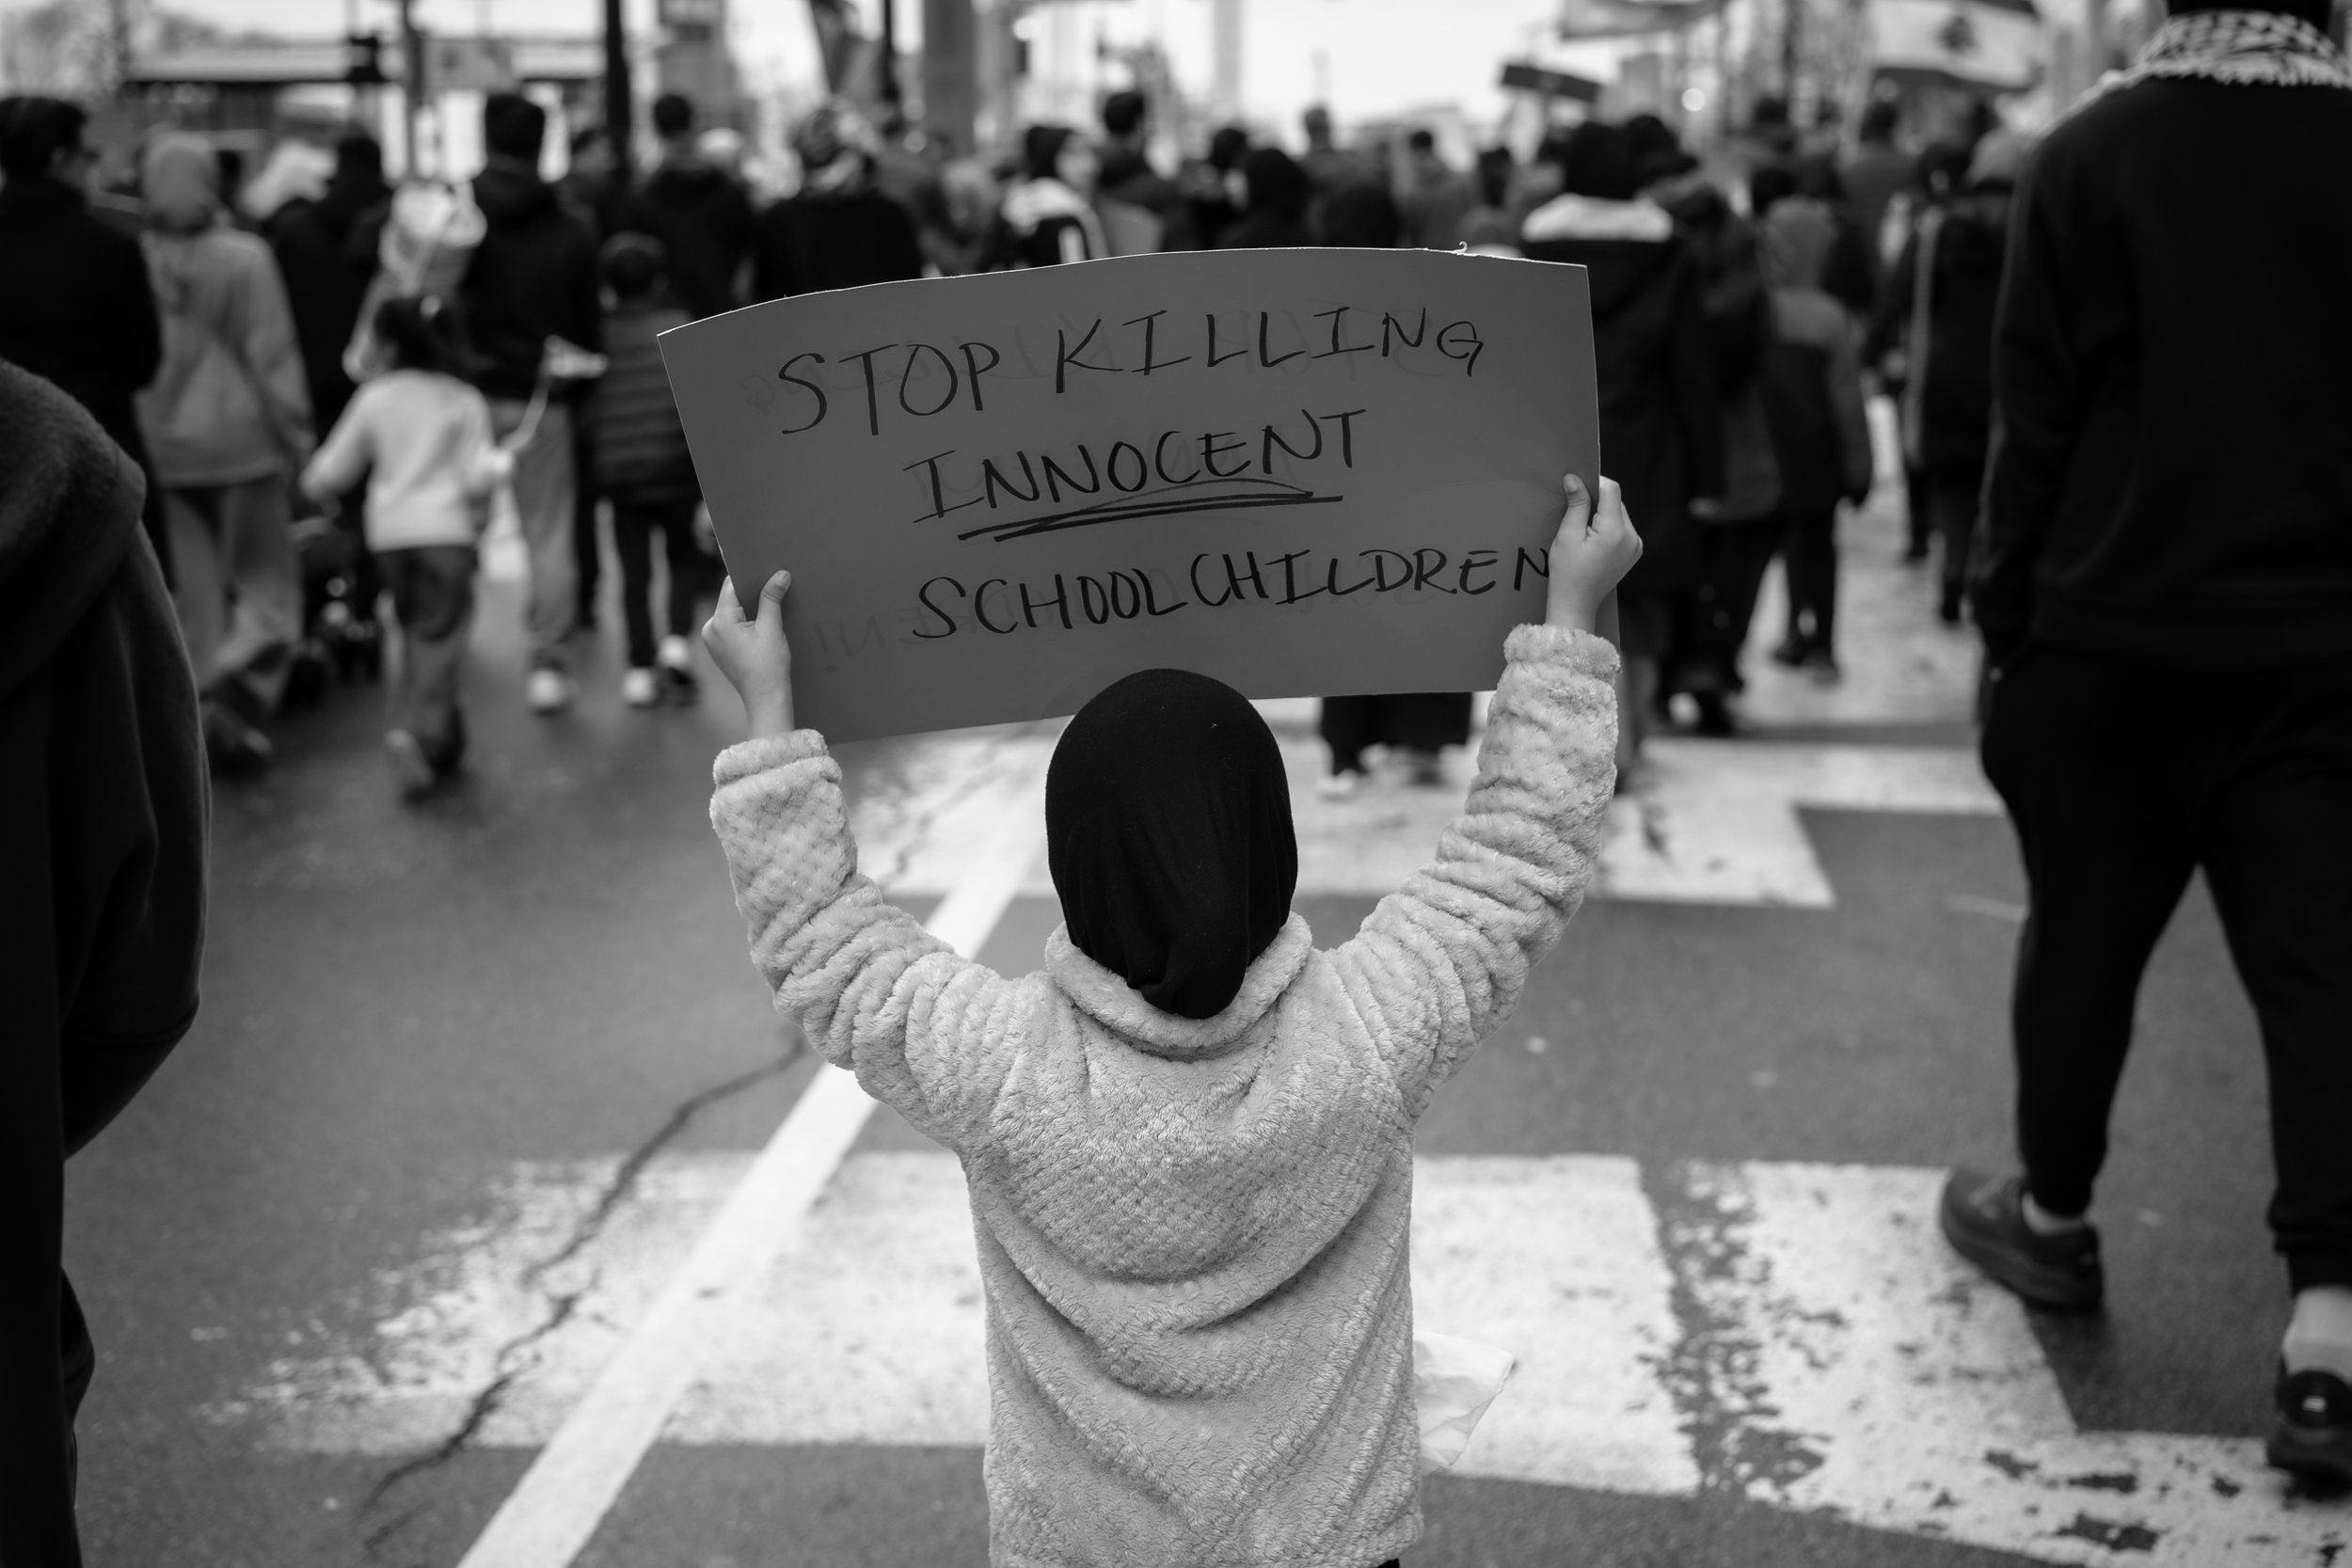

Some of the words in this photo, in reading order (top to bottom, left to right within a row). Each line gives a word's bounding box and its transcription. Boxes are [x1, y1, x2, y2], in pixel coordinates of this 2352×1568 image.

[777, 342, 1001, 436] STOP
[1056, 307, 1485, 394] KILLING
[903, 408, 1367, 524] INNOCENT
